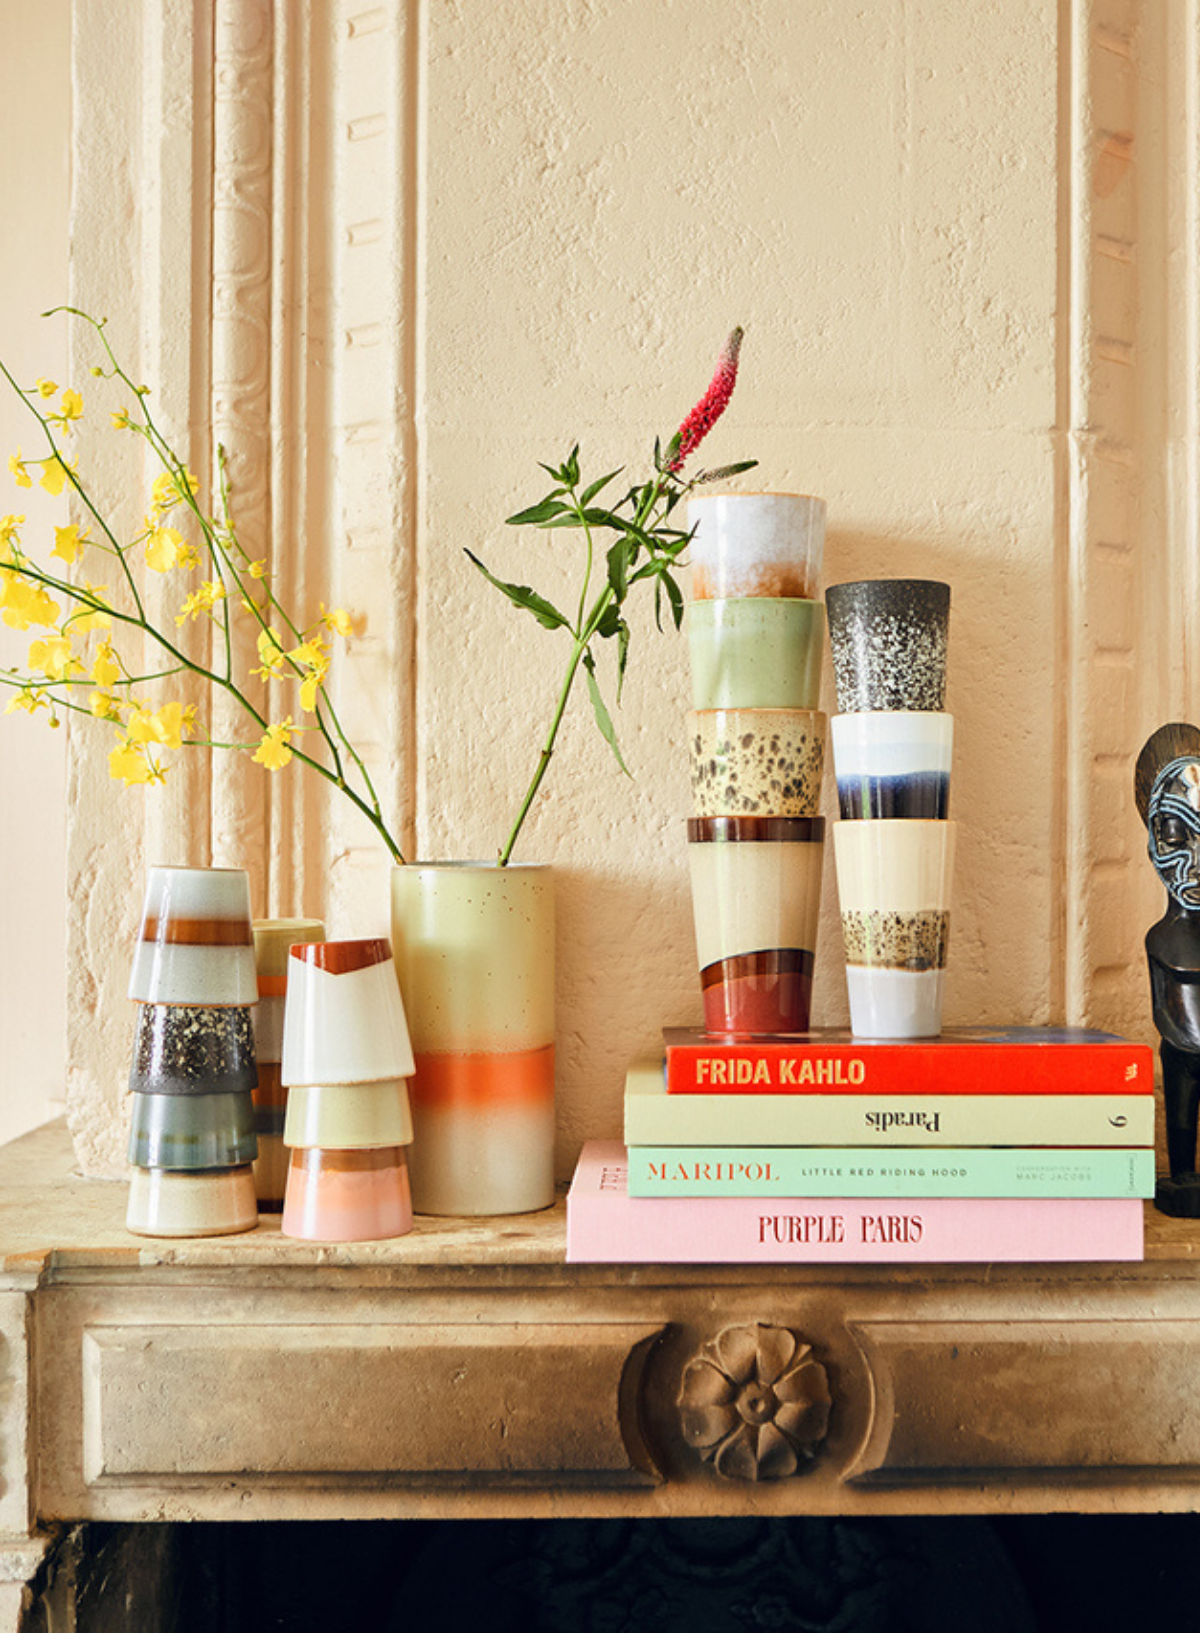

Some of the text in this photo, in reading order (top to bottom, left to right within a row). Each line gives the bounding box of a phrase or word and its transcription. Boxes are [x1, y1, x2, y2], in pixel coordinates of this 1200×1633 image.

[696, 1058, 866, 1085] FRIDA KAHLO
[864, 1111, 941, 1132] Paradis
[647, 1162, 781, 1181] MARIPOL
[801, 1168, 968, 1177] LITTLE RED RIDING HOOD
[758, 1215, 923, 1243] PURPLE PARIS
